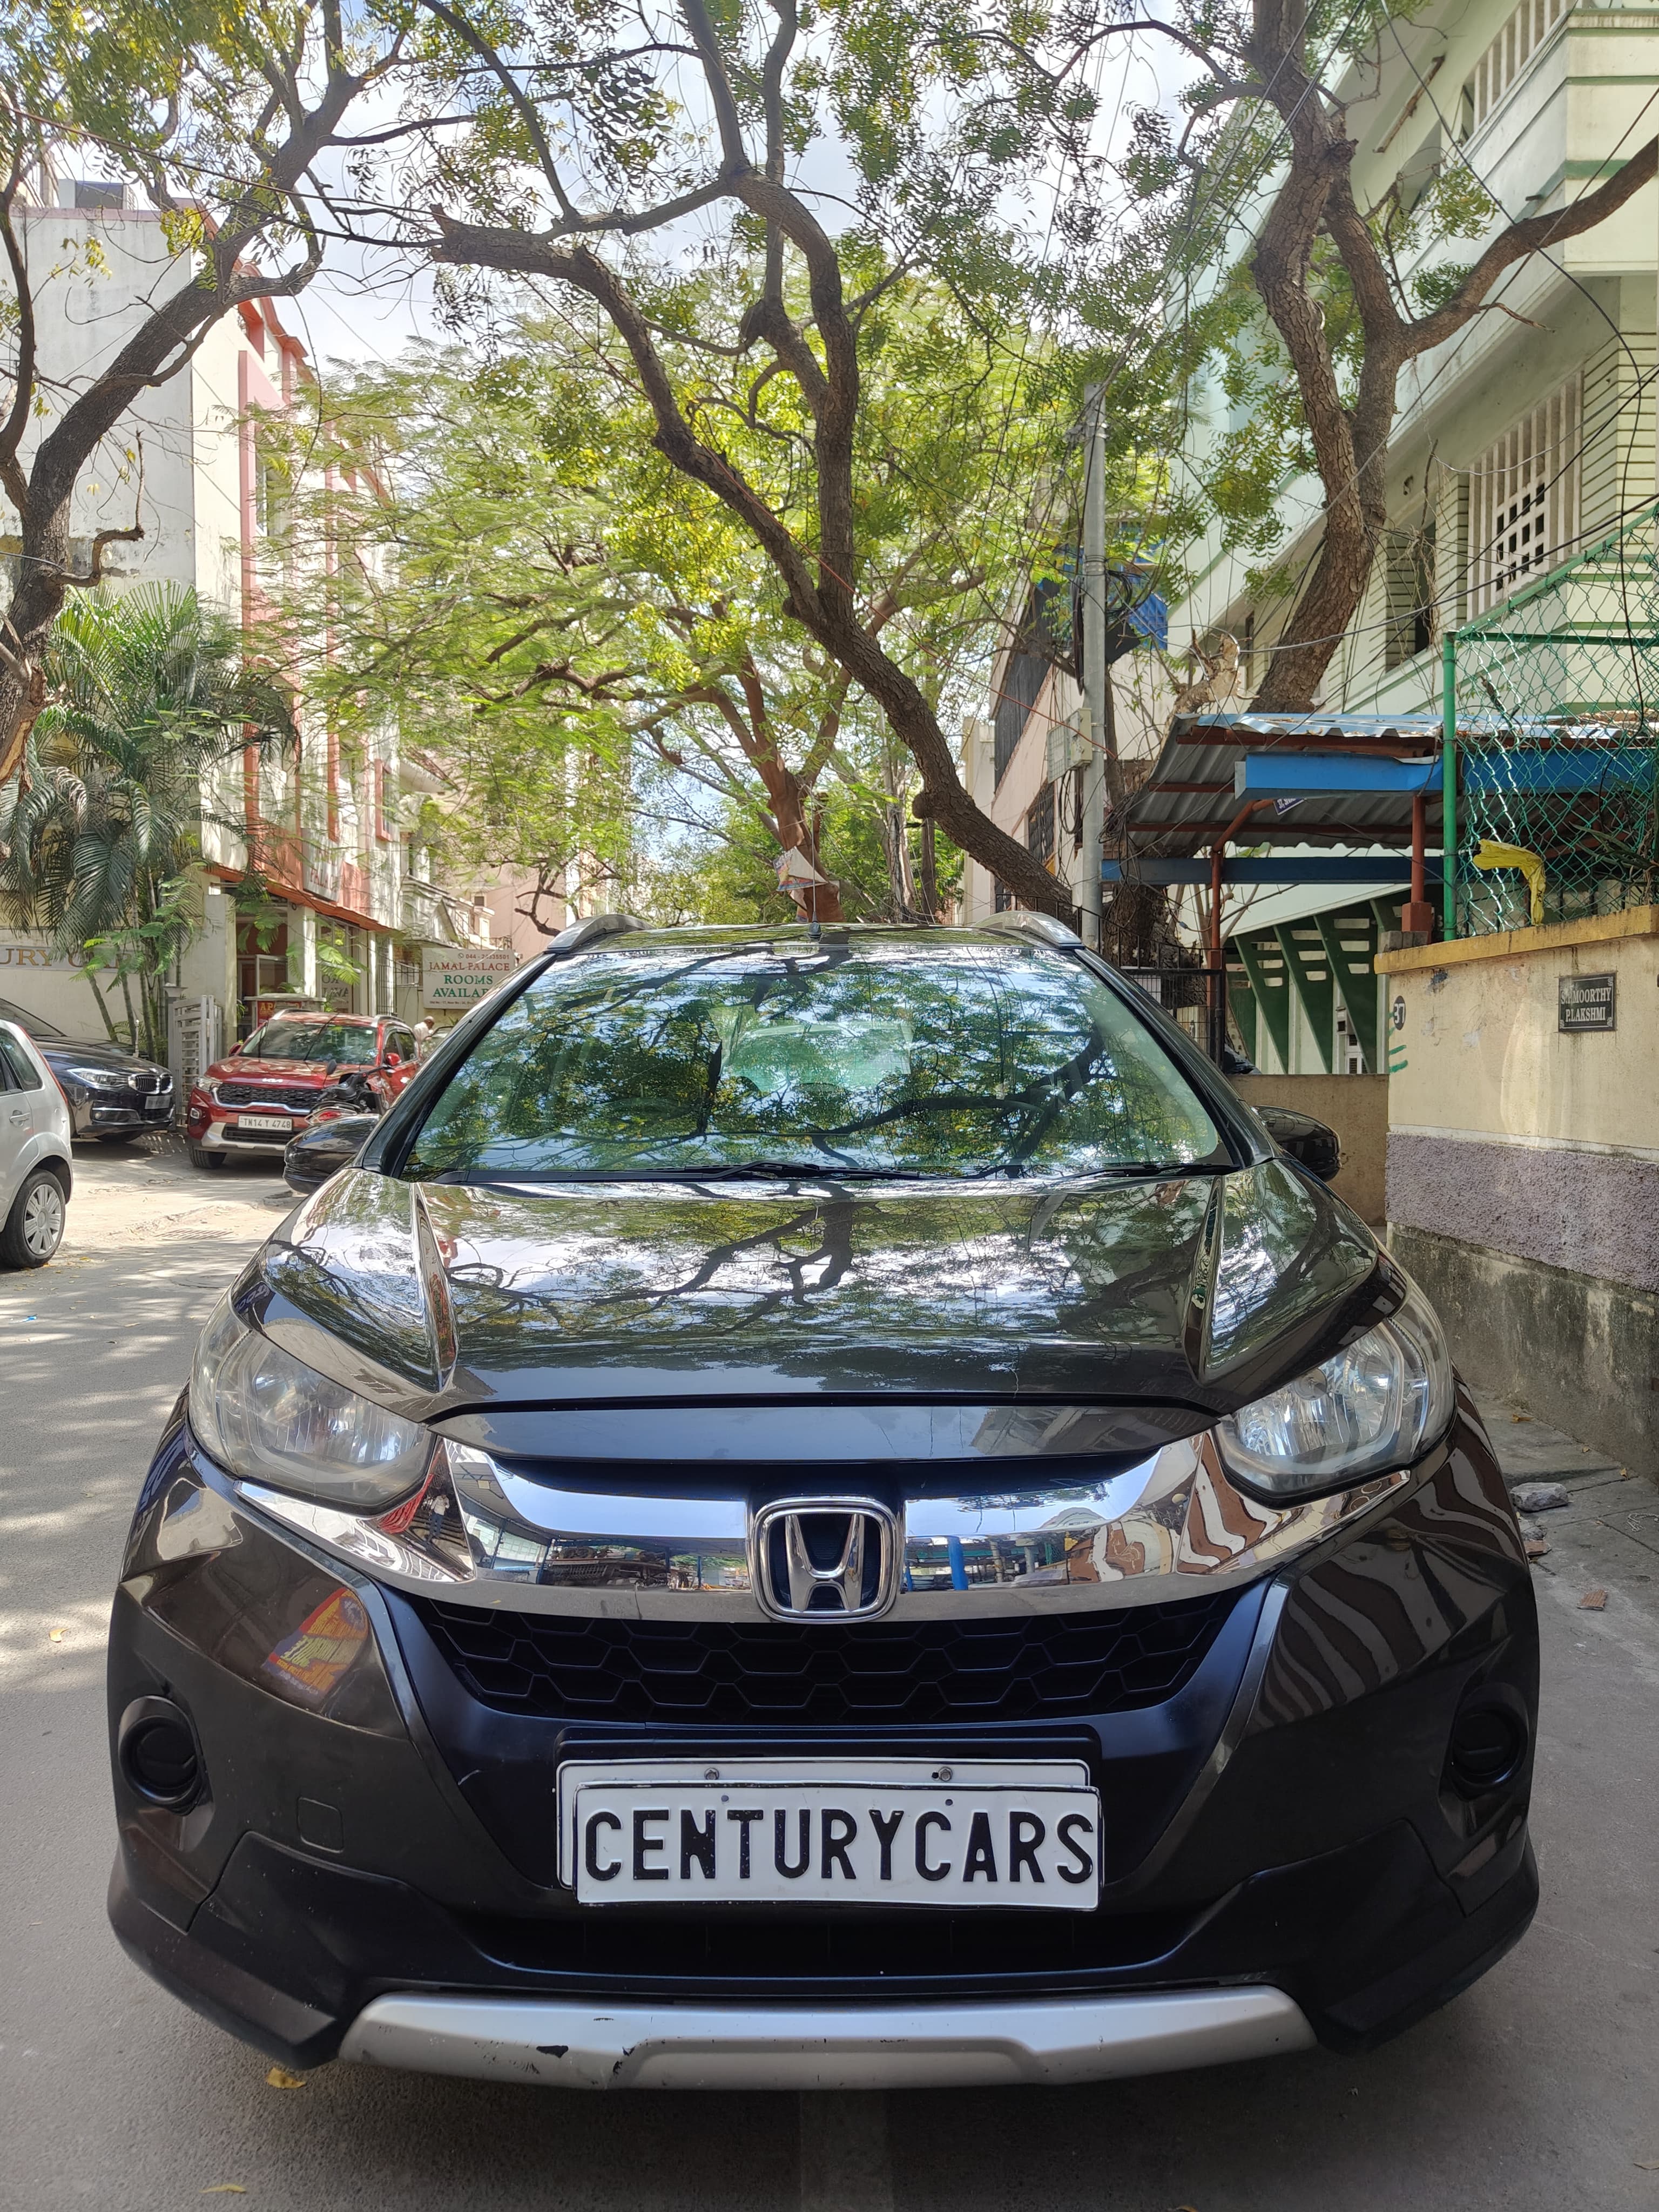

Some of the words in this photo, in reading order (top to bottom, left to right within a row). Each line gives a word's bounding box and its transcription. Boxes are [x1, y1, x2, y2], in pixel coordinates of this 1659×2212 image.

[429, 962, 465, 970] JAMAL
[468, 963, 510, 971] PALACE
[444, 974, 493, 984] ROOMS
[1394, 1003, 1405, 1023] 37
[1566, 1007, 1606, 1022] P.LAKSHMI
[244, 1118, 262, 1127] TN14
[272, 1120, 291, 1128] 4748
[585, 1809, 1094, 1884] CENTURYCARS
